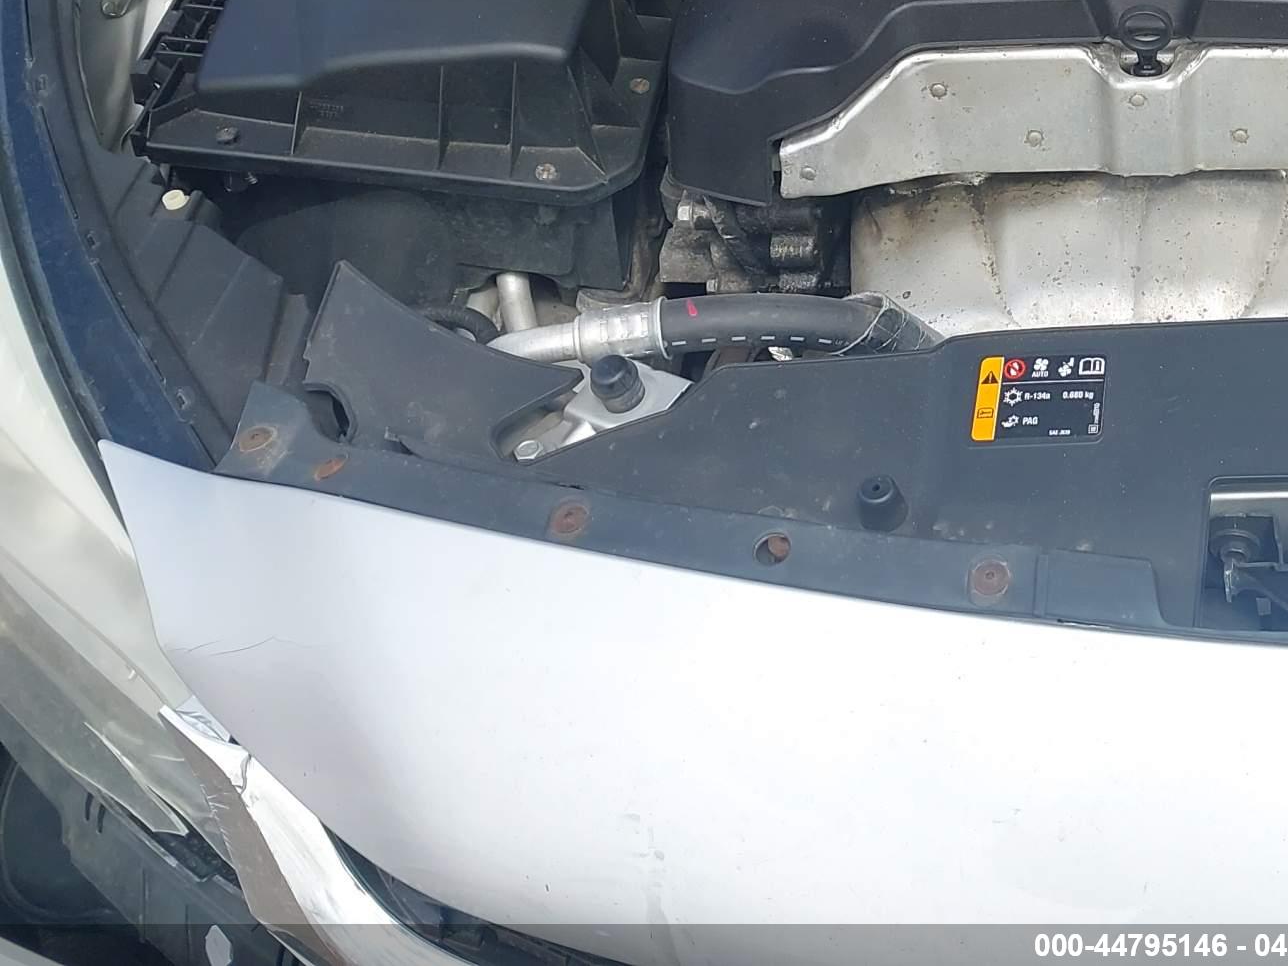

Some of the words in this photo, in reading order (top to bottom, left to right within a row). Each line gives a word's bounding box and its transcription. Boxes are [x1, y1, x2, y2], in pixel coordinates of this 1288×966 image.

[1031, 370, 1049, 378] AUTO
[1023, 392, 1051, 400] R-134a
[1084, 391, 1095, 400] kg
[1022, 416, 1039, 425] PAG
